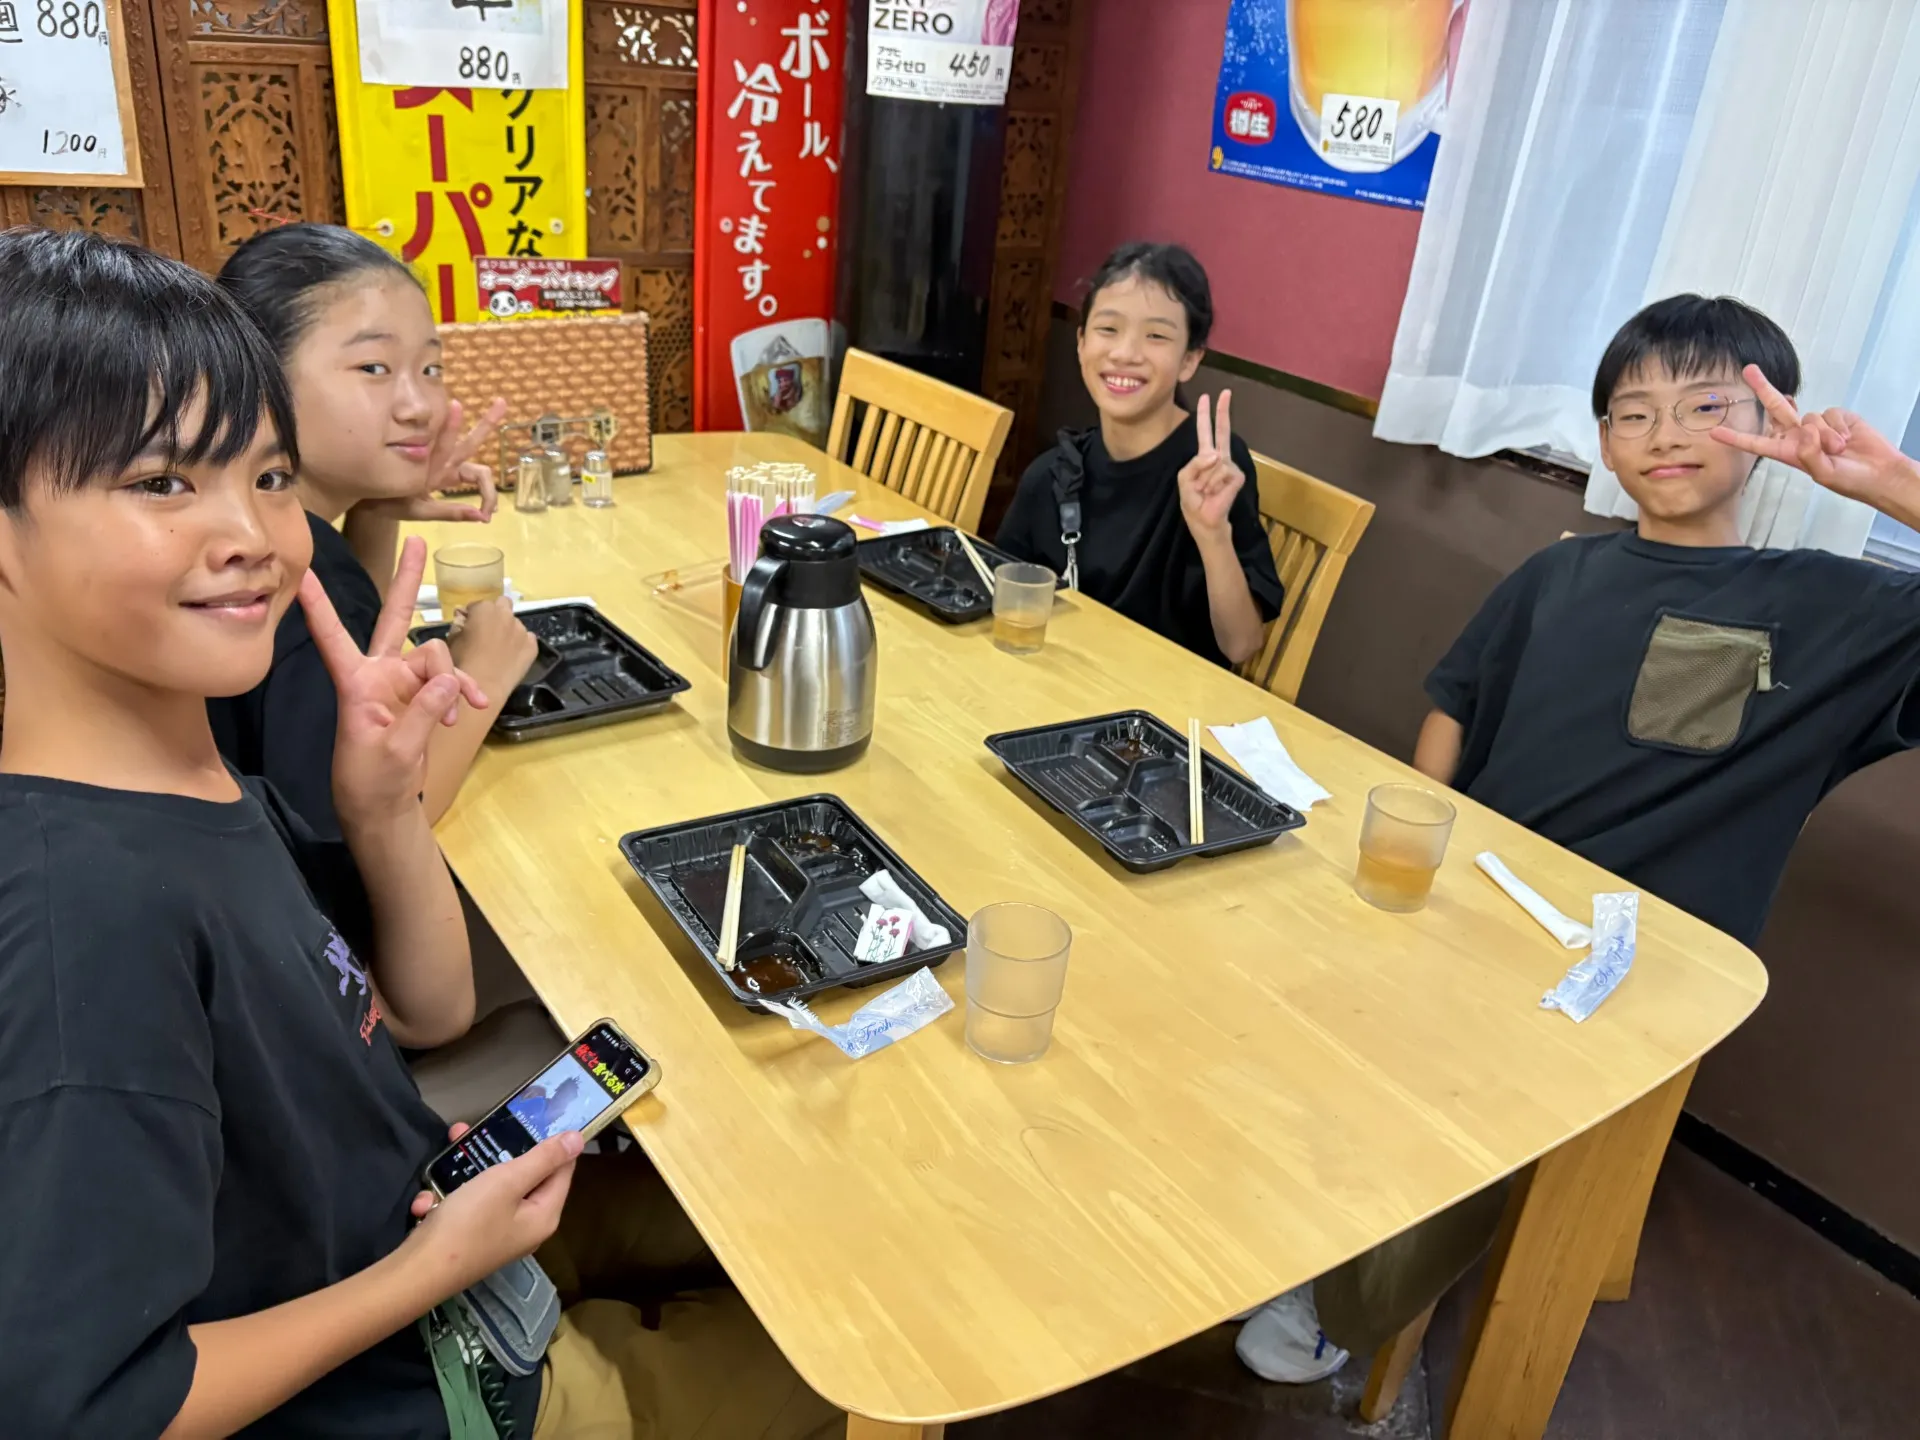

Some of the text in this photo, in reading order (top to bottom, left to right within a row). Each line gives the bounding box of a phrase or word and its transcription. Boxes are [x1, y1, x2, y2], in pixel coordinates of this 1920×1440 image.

[874, 8, 954, 35] ZERO
[727, 59, 782, 317] 冷えてます。
